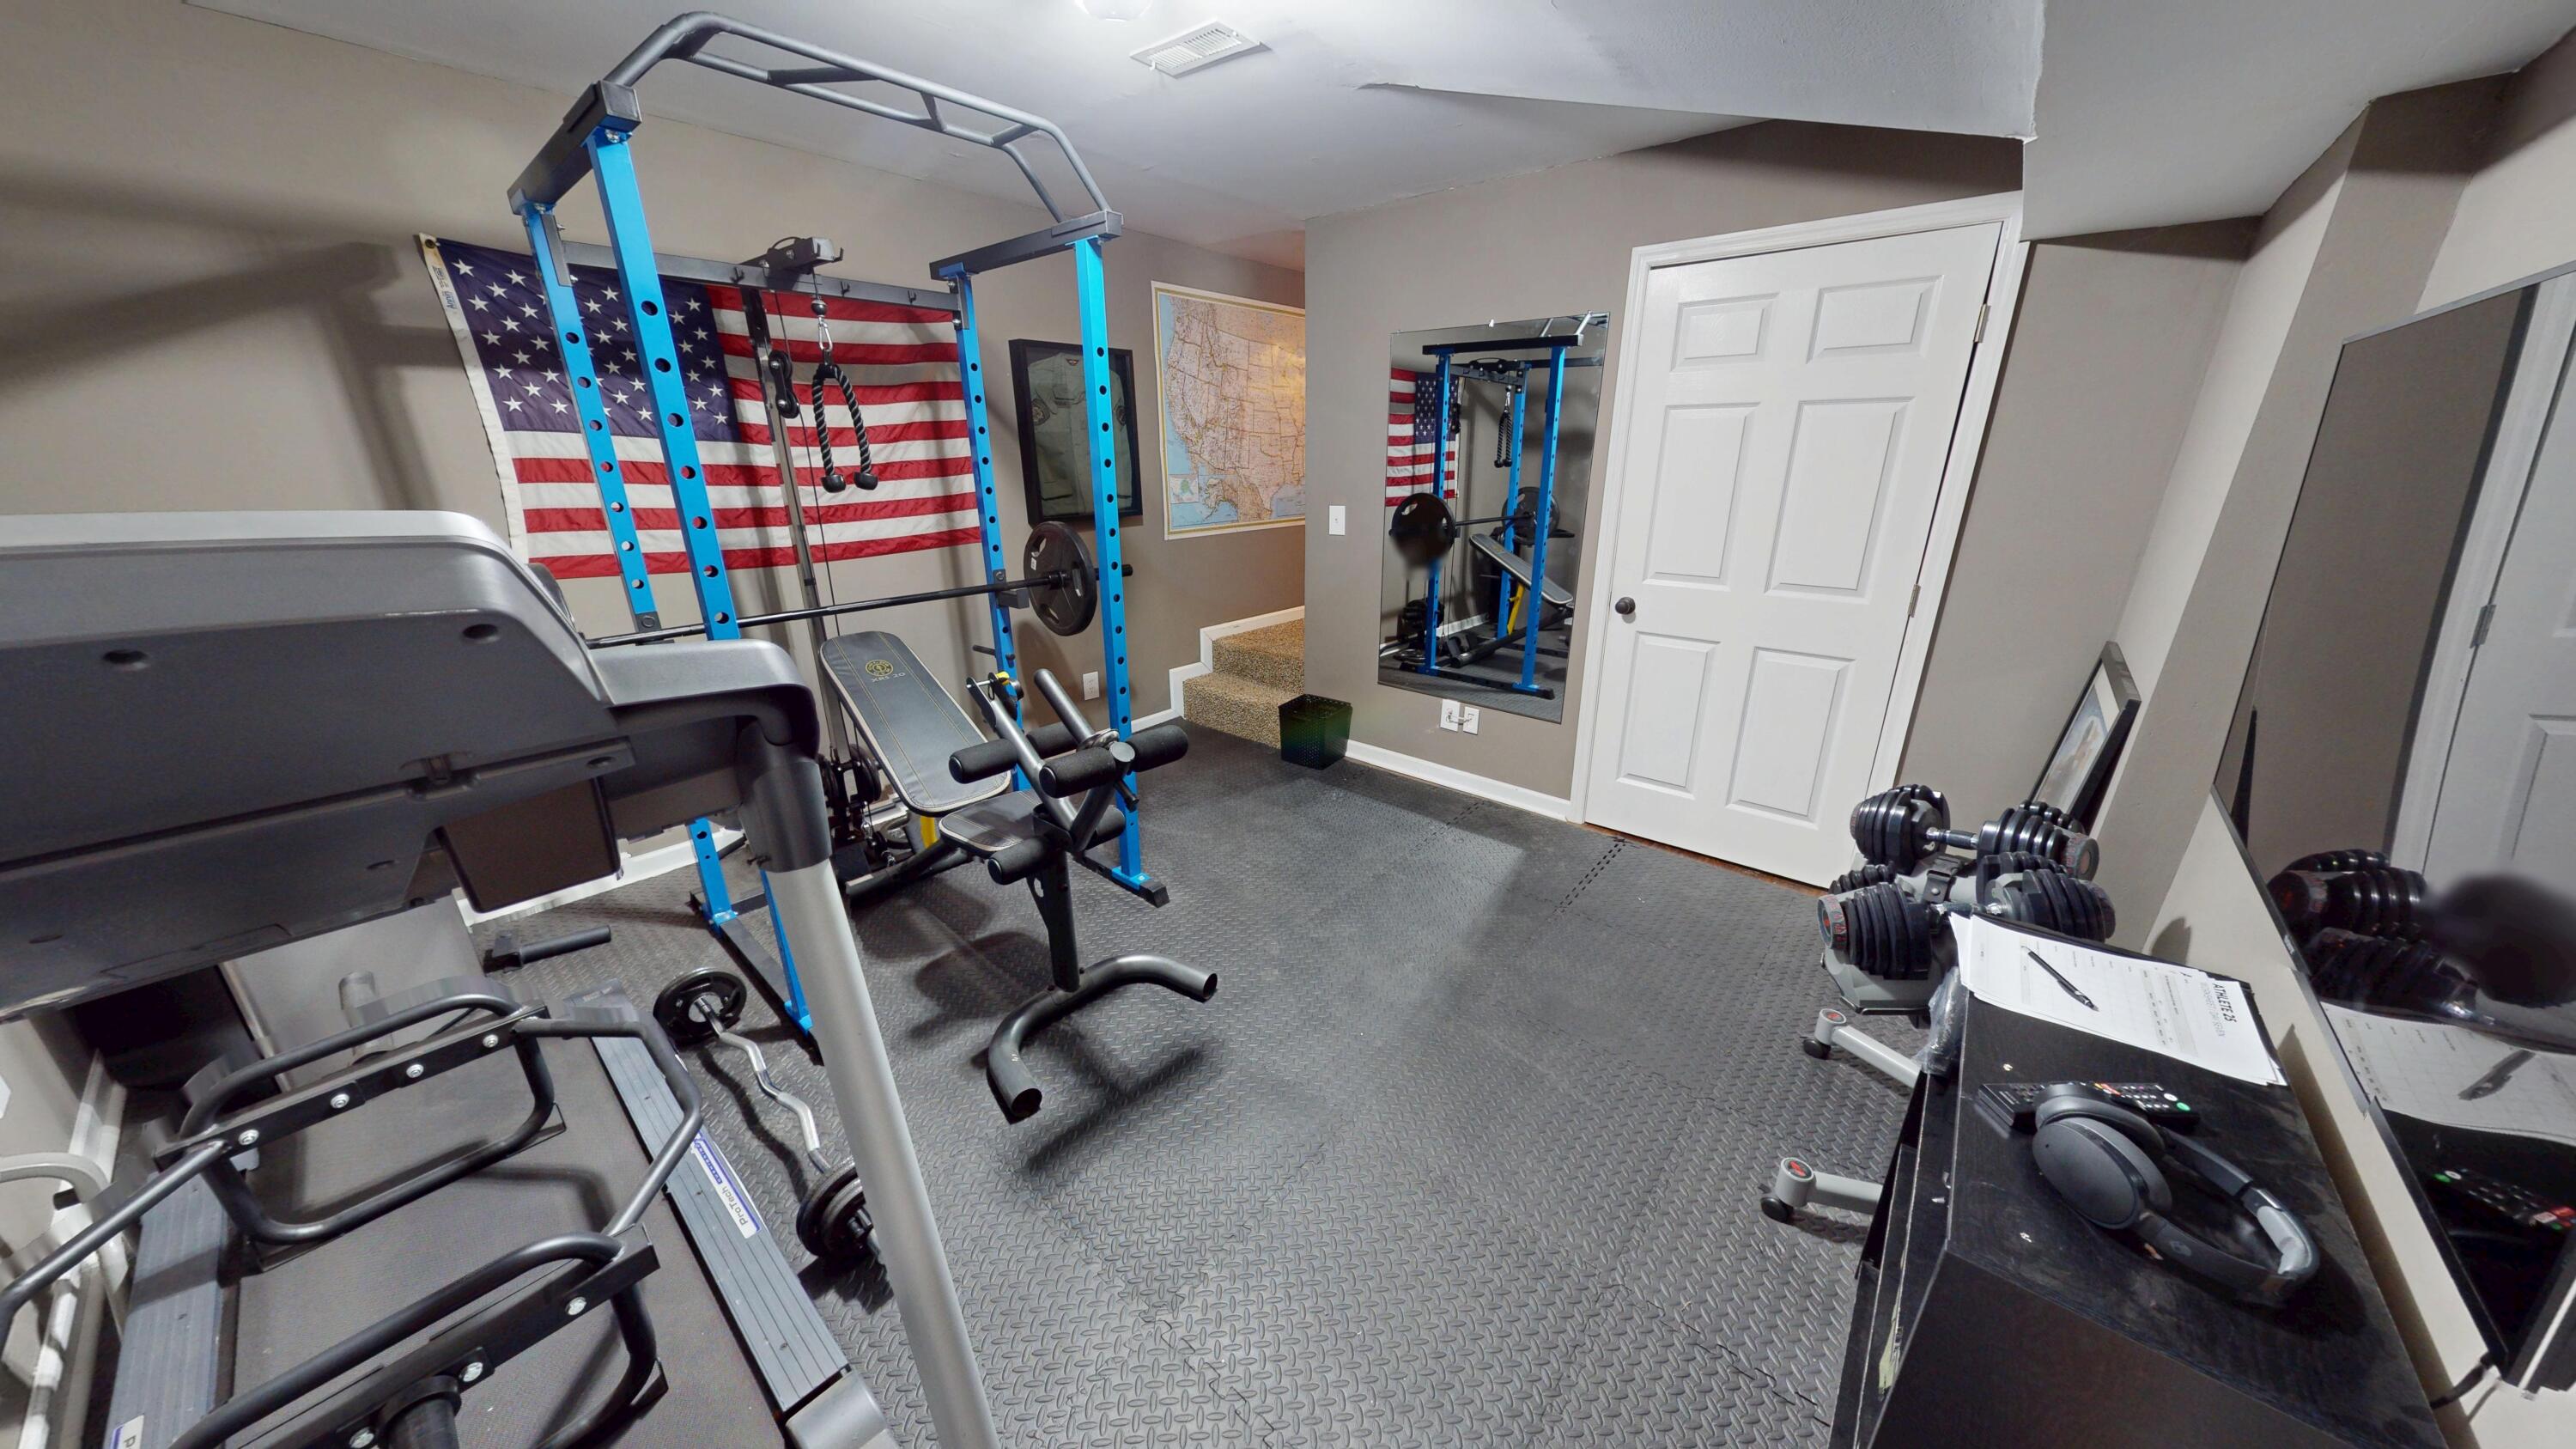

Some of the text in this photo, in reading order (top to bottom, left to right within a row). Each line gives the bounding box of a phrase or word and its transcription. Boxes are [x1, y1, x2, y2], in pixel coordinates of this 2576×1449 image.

[2212, 983, 2237, 1022] ATHLETE 25
[721, 1186, 748, 1226] ProTech
